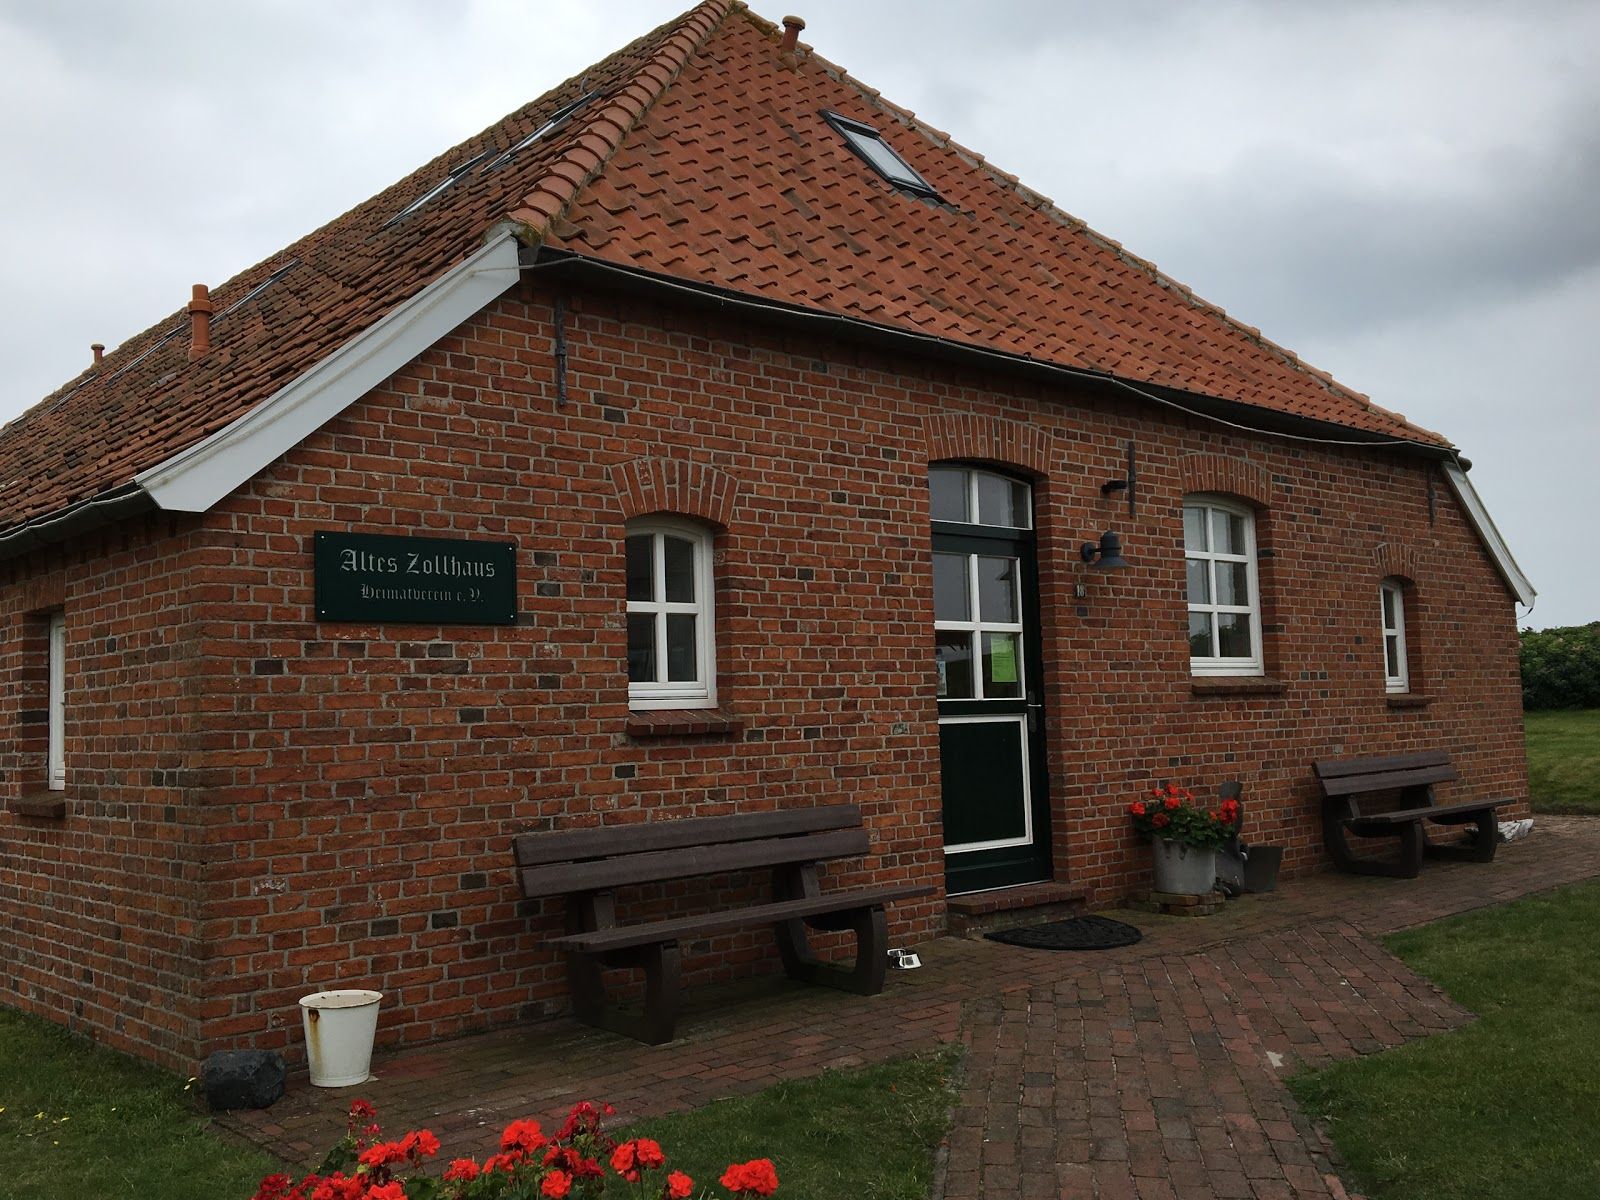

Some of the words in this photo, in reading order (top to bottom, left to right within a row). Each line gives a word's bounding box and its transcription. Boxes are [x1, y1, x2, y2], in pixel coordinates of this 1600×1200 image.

[339, 548, 398, 573] Altes
[406, 552, 495, 577] Zollhaus
[361, 583, 452, 601] Heimatverein
